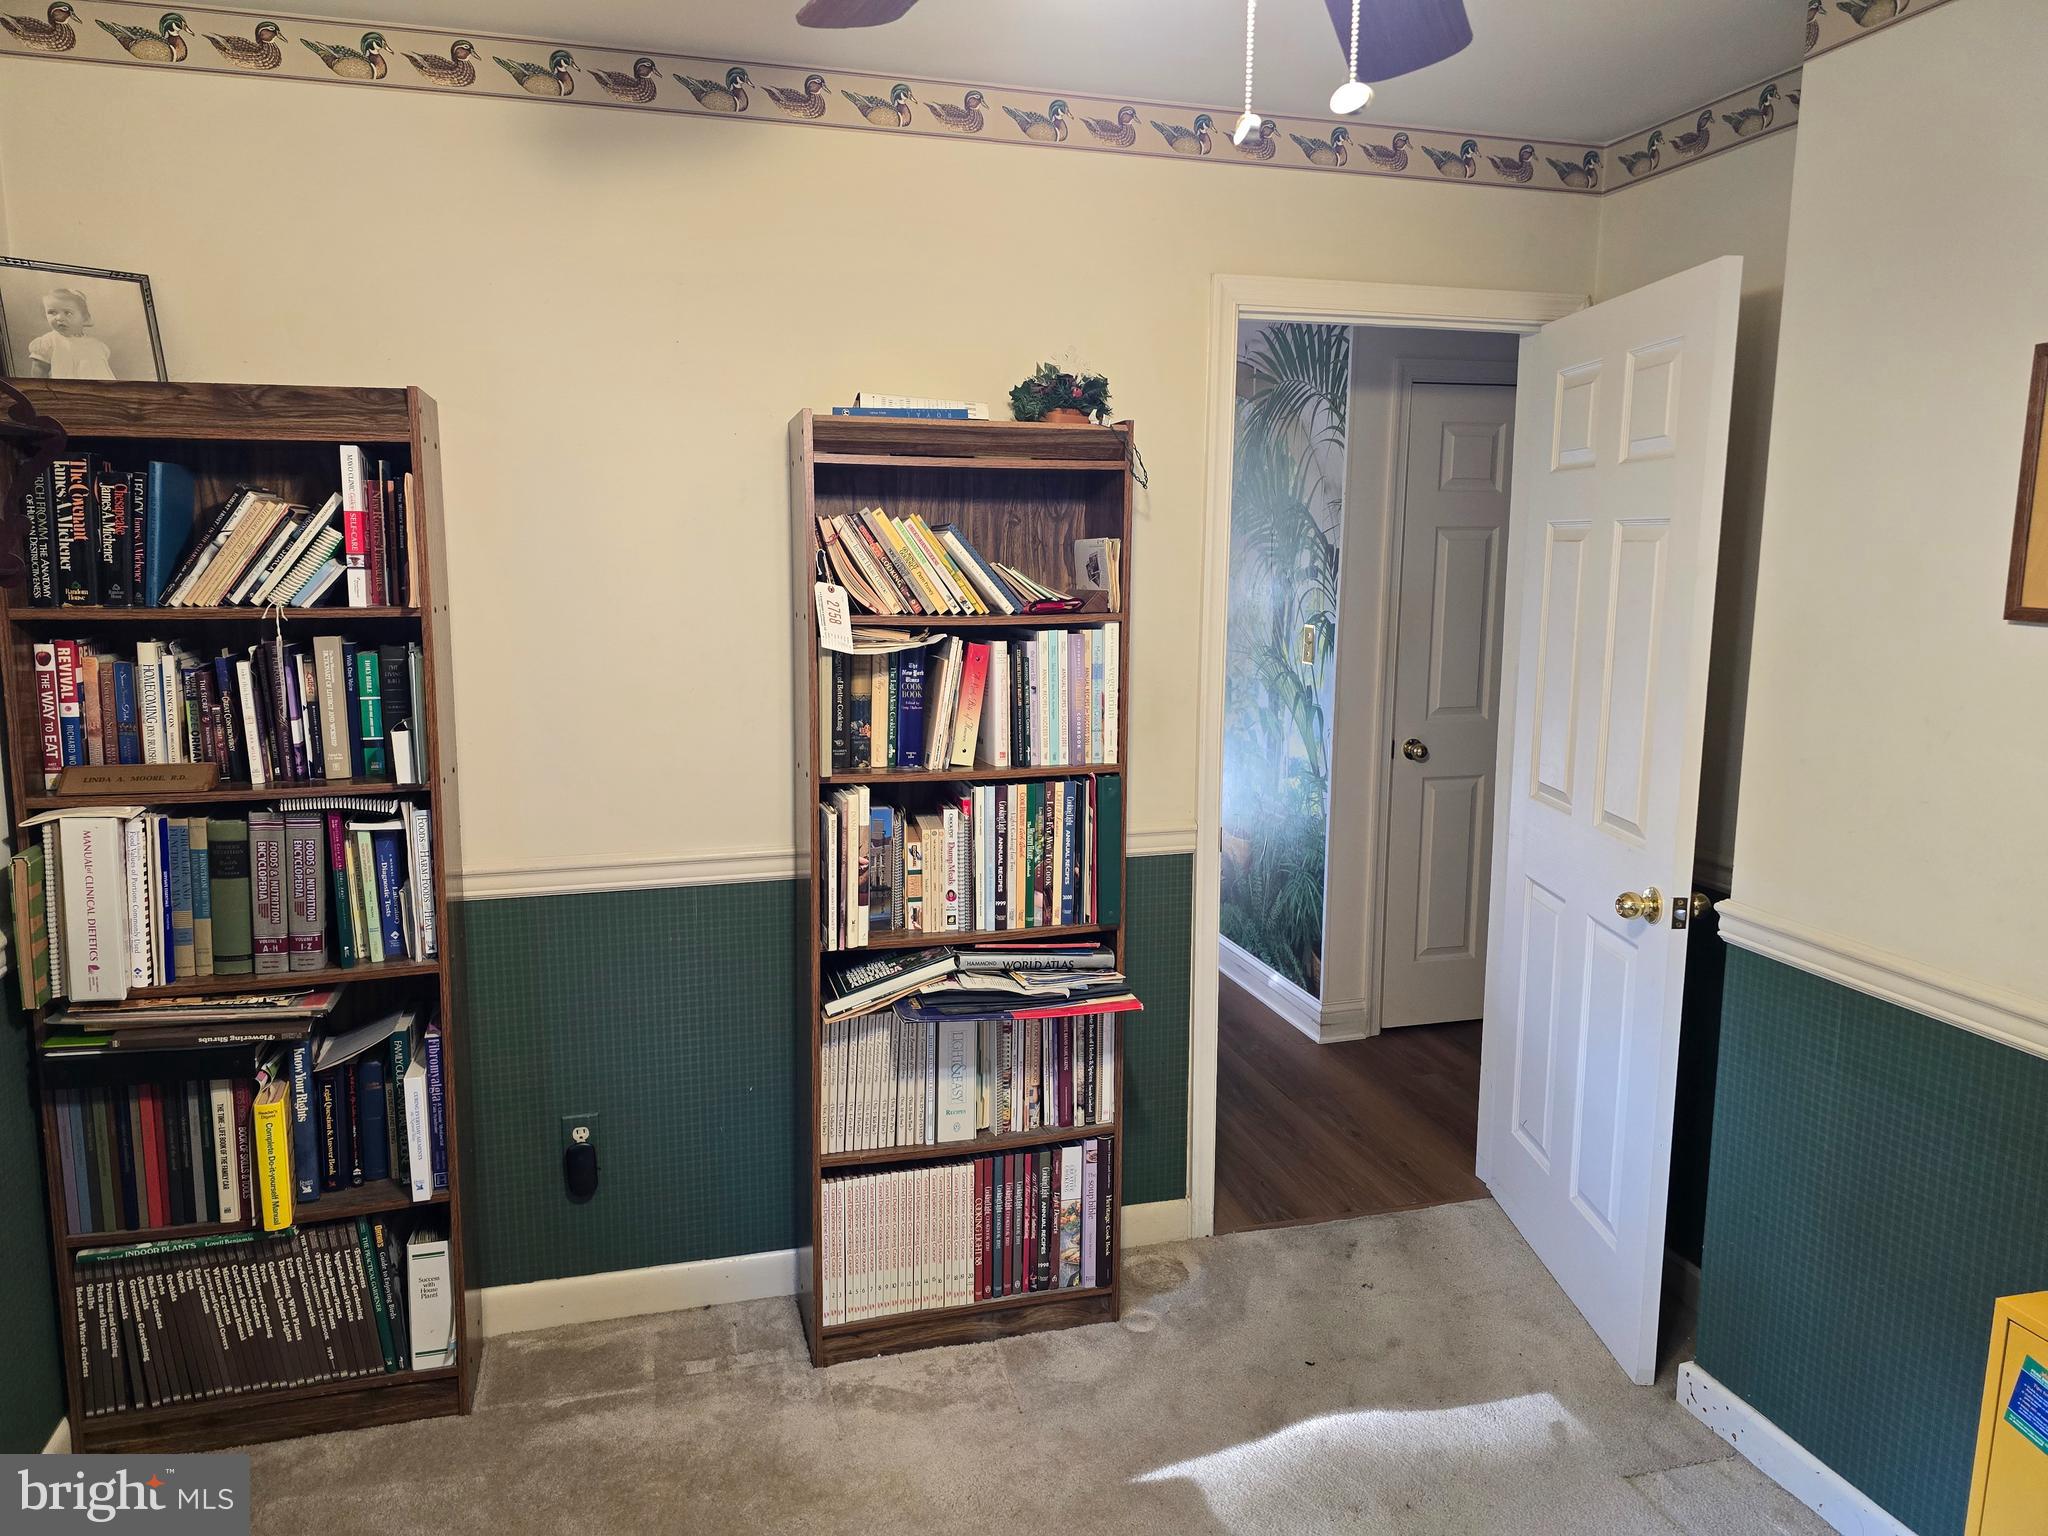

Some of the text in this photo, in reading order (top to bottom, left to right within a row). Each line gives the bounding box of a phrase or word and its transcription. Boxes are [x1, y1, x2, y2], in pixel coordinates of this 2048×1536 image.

[52, 460, 71, 497] James
[346, 454, 354, 472] MAYO
[99, 482, 114, 510] James
[134, 478, 144, 514] LEGACY
[347, 473, 355, 492] CLINIC
[25, 494, 34, 505] OF
[68, 458, 90, 541] The Covenant
[113, 483, 128, 535] Chesapeake
[34, 473, 51, 598] RICH FROMM THE ANATOMY
[57, 513, 74, 572] Michener
[102, 522, 117, 564] Michener
[134, 517, 144, 539] James
[349, 512, 358, 552] SELF-CARE
[29, 537, 41, 599] DESTRUCTIVENESS
[880, 557, 905, 588] COOKING
[826, 600, 842, 625] 2758
[57, 647, 74, 699] REVIVAL
[837, 676, 843, 684] of
[908, 662, 918, 670] The
[143, 664, 157, 724] HOMECOMING
[199, 680, 209, 712] THE SECRET
[902, 690, 922, 698] BOOK
[1106, 667, 1116, 719] vegetarian
[40, 674, 59, 759] THE WAY TO EAT
[190, 703, 199, 729] SUZE
[836, 704, 844, 731] Cooking
[66, 724, 76, 753] RICHARD
[224, 713, 235, 752] CONTROVERSY
[129, 831, 138, 847] Food
[417, 817, 428, 843] FOODS
[83, 830, 93, 868] MANUAL
[129, 848, 139, 867] Values
[269, 841, 279, 867] FOODS
[306, 840, 315, 865] FOODS
[946, 842, 955, 885] Dump Meals
[257, 841, 268, 900] ENCYCLOPEDIA
[294, 840, 304, 898] ENCYCLOPEDIA
[85, 875, 95, 916] CLINICAL
[131, 877, 140, 903] Portions
[270, 880, 280, 924] NUTRITION
[307, 878, 316, 921] NUTRITION
[381, 861, 392, 918] Diagnostic Tests
[132, 904, 140, 937] Commonly
[87, 918, 98, 962] DIETETICS
[133, 938, 141, 954] Used
[1002, 961, 1043, 971] WORLD
[1043, 960, 1074, 970] ATLAS
[198, 1031, 276, 1044] Flowering Shrubs
[293, 1047, 310, 1123] Know Your Rights
[427, 1038, 442, 1103] Fibromyalgia
[323, 1084, 333, 1101] Legal
[323, 1101, 334, 1129] Question
[218, 1137, 226, 1149] BOOK
[325, 1135, 335, 1158] Answer
[221, 1165, 229, 1180] FAMILY
[264, 1122, 281, 1226] Complete Do-it-yourself Manual
[327, 1159, 336, 1176] Book
[1087, 1180, 1096, 1220] soup bible
[1104, 1194, 1112, 1224] Heritage
[125, 1247, 159, 1258] INDOOR
[161, 1242, 197, 1253] PLANTS
[890, 1223, 898, 1248] Cooking
[176, 1270, 186, 1294] Roses
[185, 1269, 194, 1290] Vines
[259, 1263, 268, 1283] Trees
[285, 1257, 295, 1278] Ferns
[354, 1247, 367, 1289] Evergreens
[86, 1283, 95, 1310] Bulbs
[117, 1279, 129, 1320] Perennials
[137, 1276, 149, 1310] Annuals
[155, 1274, 166, 1296] Herbs
[166, 1274, 177, 1302] Orchids
[193, 1268, 210, 1314] Easy Gardens
[295, 1256, 316, 1328] Garden Construction
[75, 1286, 90, 1378] Rock and Water Gardens
[96, 1283, 108, 1350] Pests and Diseases
[104, 1282, 114, 1313] Pruning
[110, 1327, 119, 1358] Grafting
[129, 1279, 150, 1362] Greenhouse Gardening
